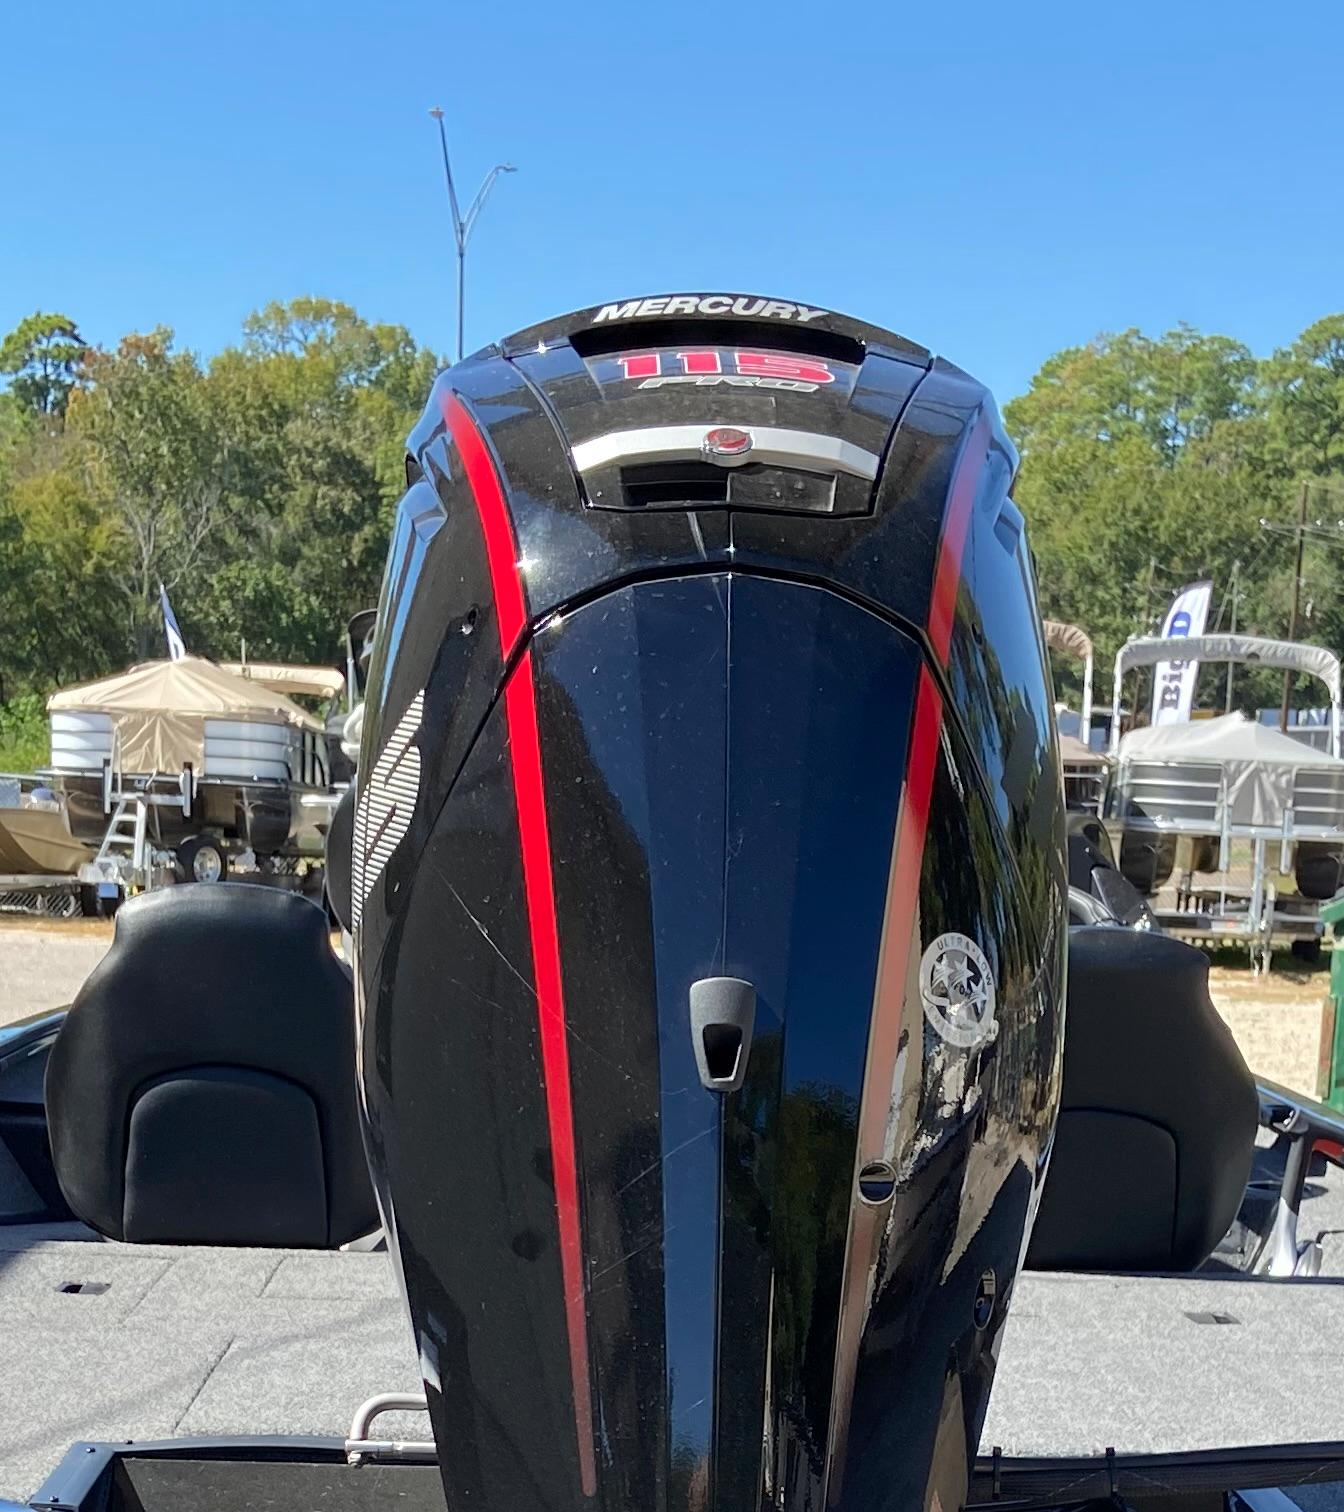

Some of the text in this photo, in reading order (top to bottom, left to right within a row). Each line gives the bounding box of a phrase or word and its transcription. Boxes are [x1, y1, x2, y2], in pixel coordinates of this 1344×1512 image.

[592, 297, 830, 323] MERCURY
[617, 352, 836, 384] 115
[637, 376, 820, 393] PRO
